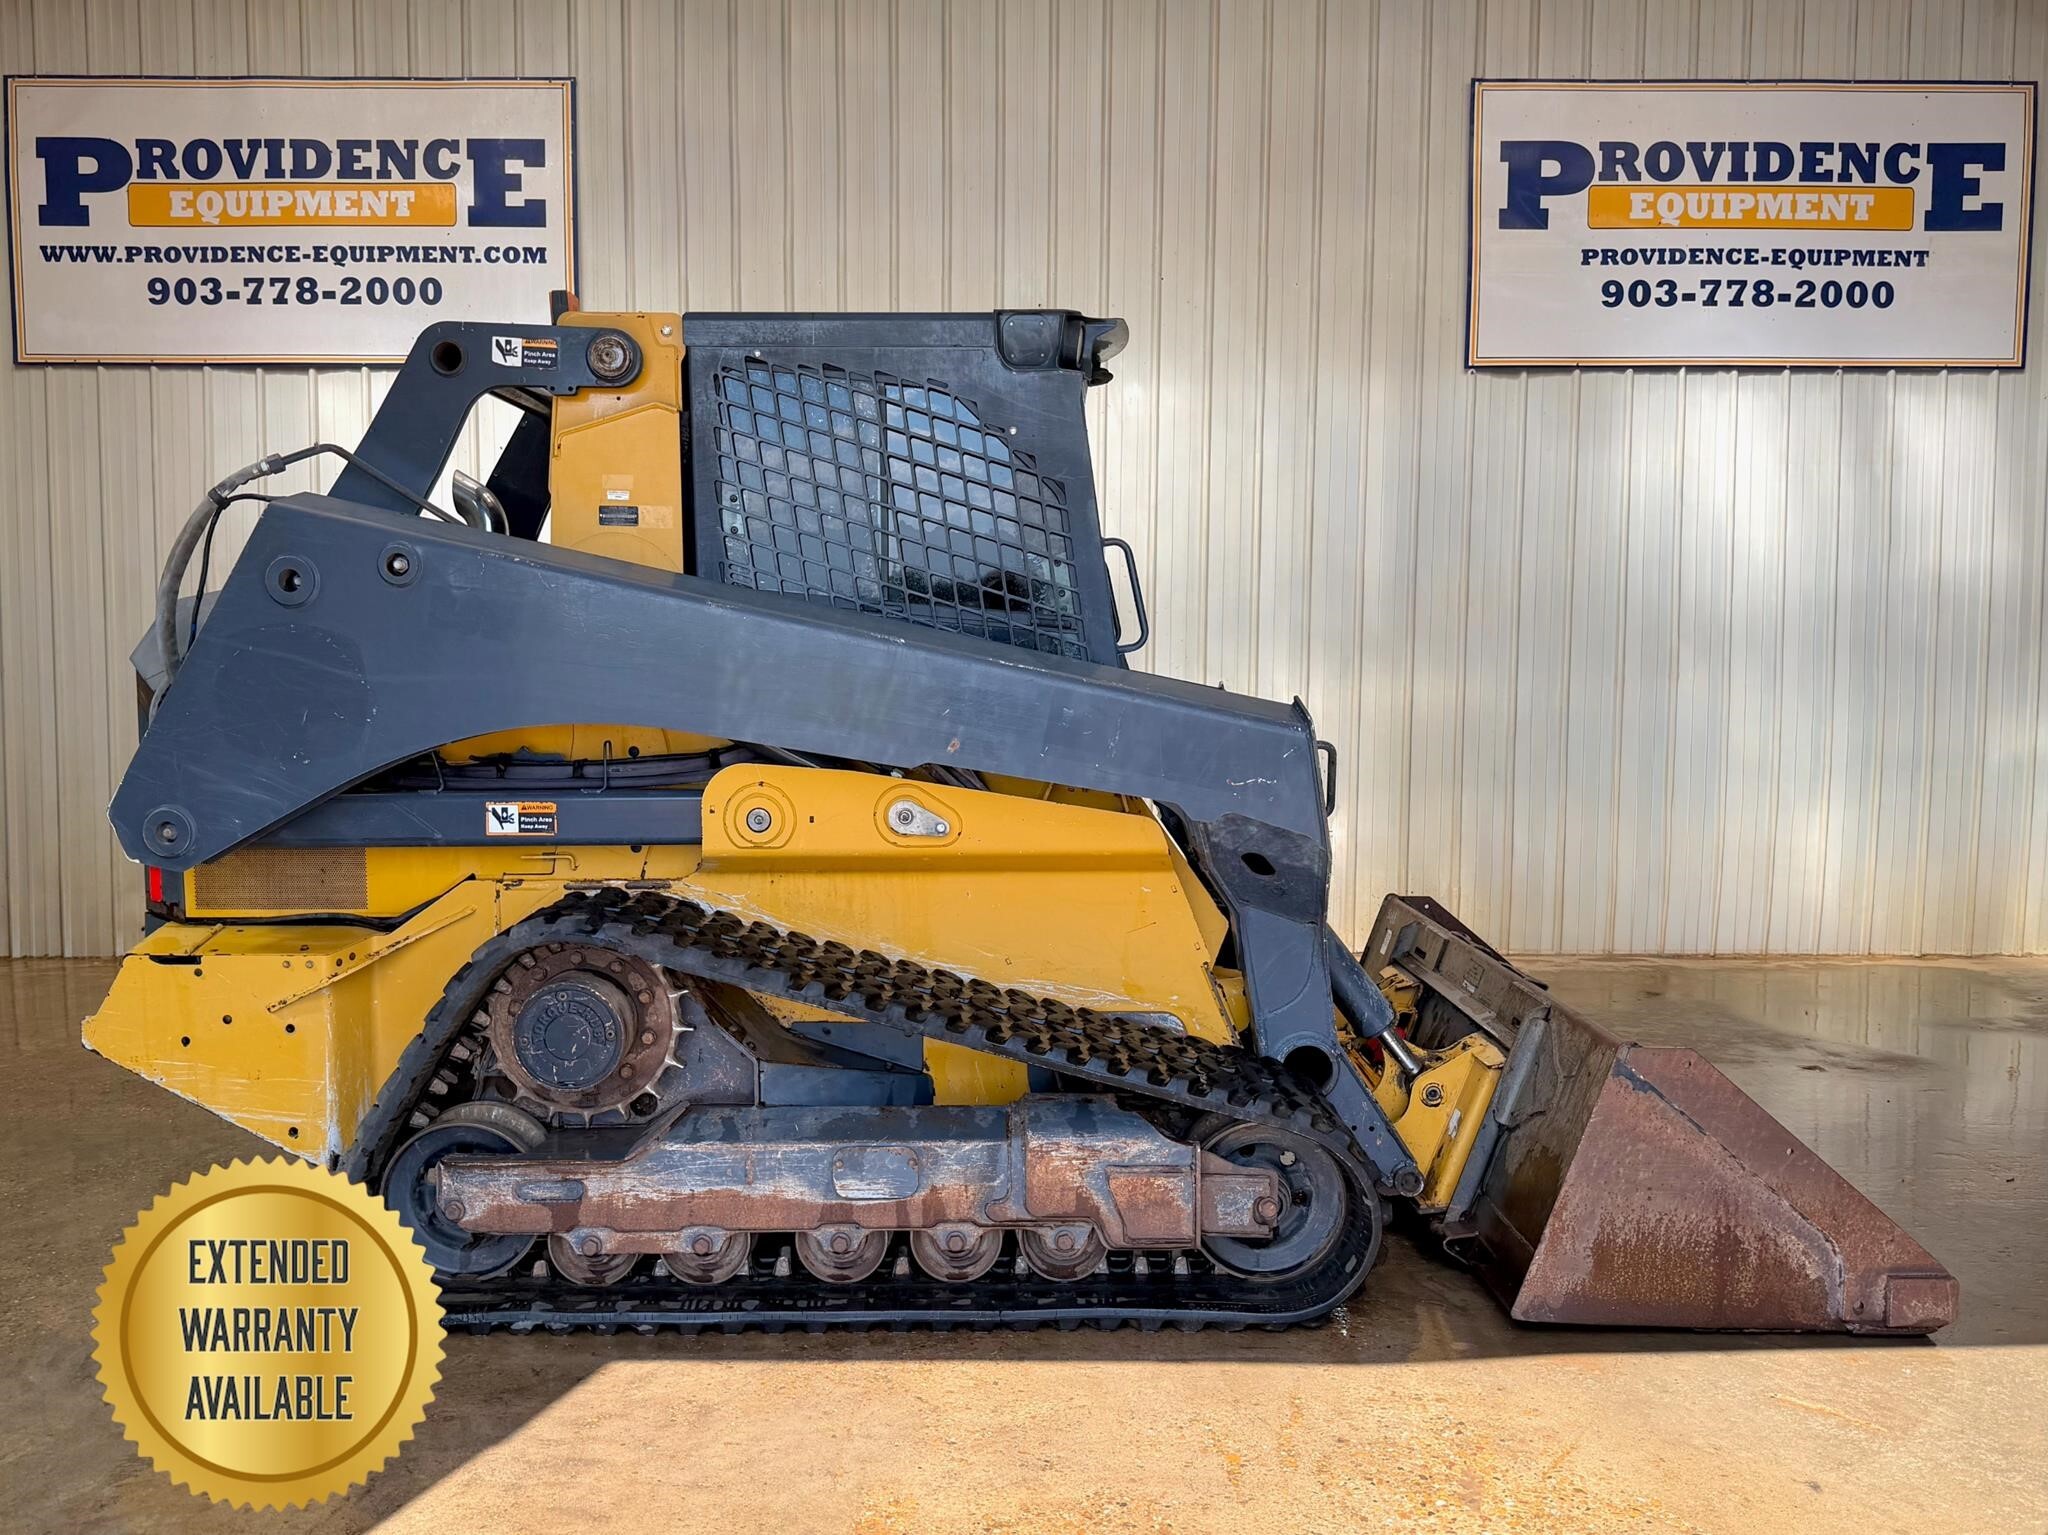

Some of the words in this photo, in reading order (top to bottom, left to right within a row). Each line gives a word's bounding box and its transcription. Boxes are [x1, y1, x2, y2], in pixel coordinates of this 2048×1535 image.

[35, 137, 547, 228] PROVIDENCE
[1498, 140, 2007, 232] PROVIDENCE
[169, 189, 416, 225] EQUIPMENT
[1629, 191, 1875, 227] EQUIPMENT
[38, 244, 548, 268] WWW.PROVIDENCE-EQUIPMENT.COM
[1580, 247, 1930, 271] PROVIDENCE-EQUIPMENT
[146, 276, 444, 306] 903-778-2000
[1600, 279, 1896, 309] 903-778-2000
[541, 350, 556, 358] Area
